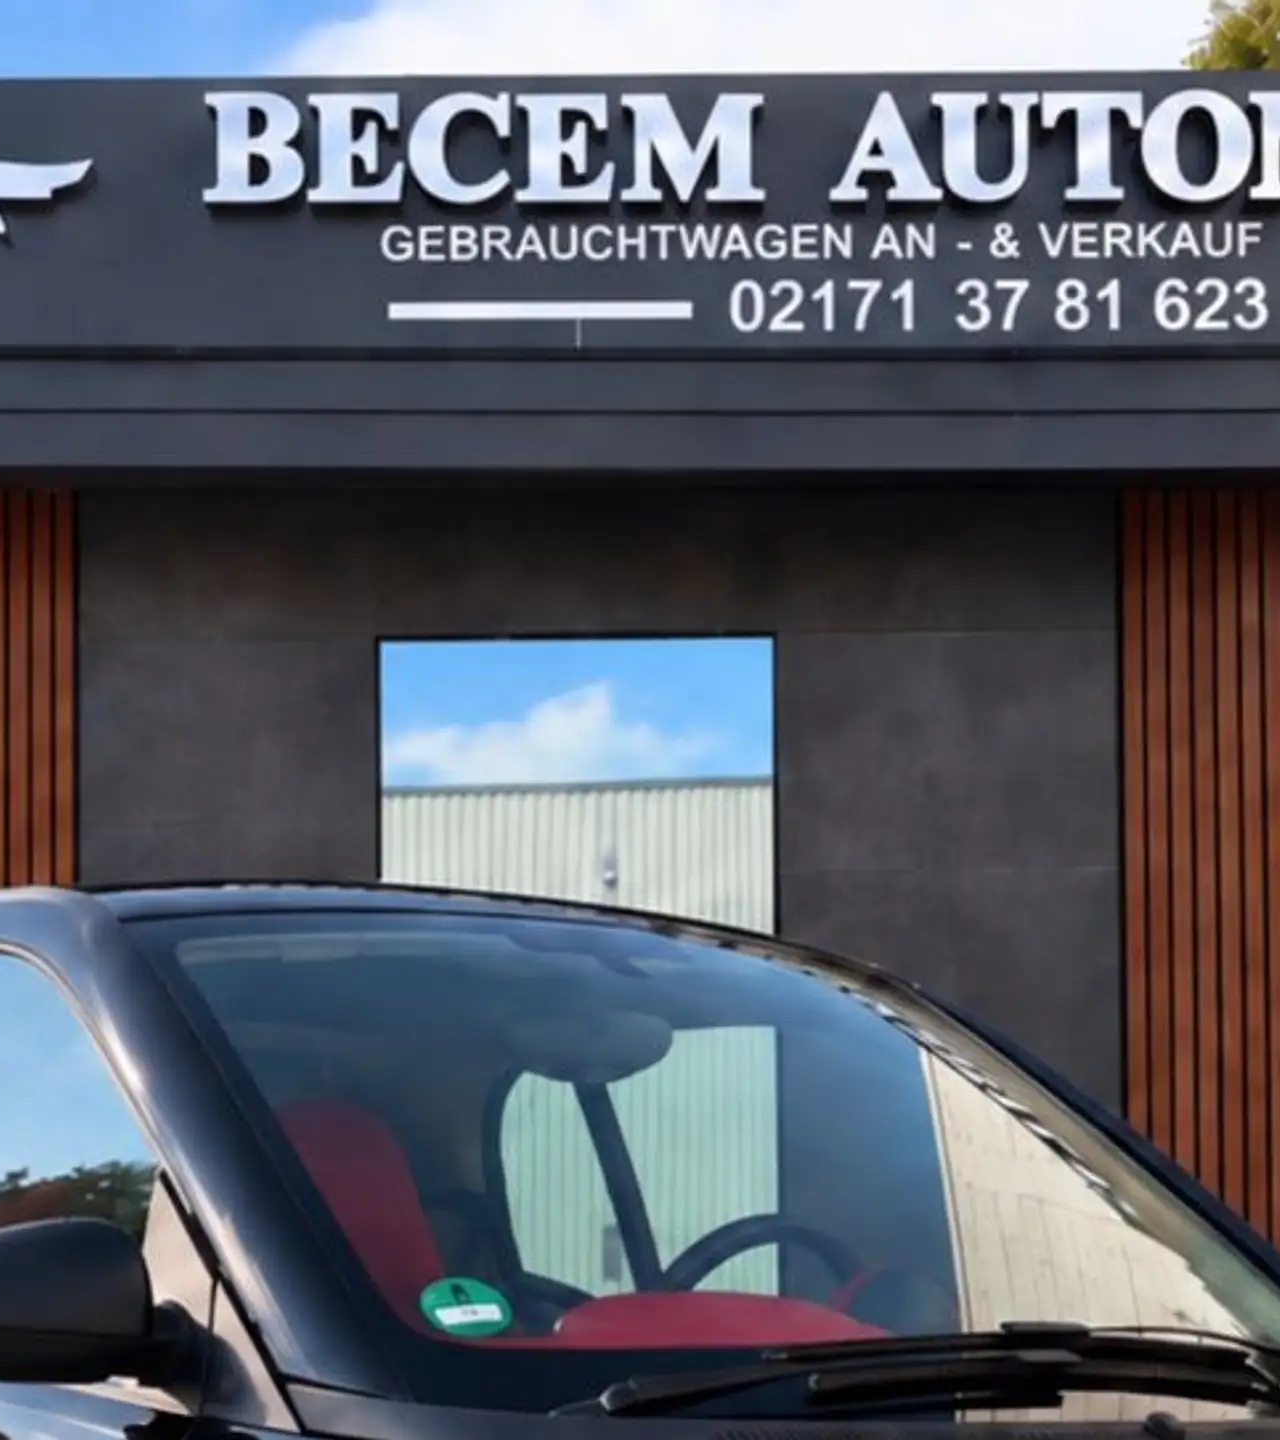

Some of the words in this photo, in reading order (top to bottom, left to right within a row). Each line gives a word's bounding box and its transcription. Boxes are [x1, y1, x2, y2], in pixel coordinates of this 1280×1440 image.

[202, 91, 766, 205] BECEM
[380, 223, 853, 262] GEBRAUCHTWAGEN
[870, 223, 936, 260] AN
[989, 222, 1021, 260] &
[1038, 221, 1263, 260] VERKAUF
[729, 279, 915, 333] 02171
[955, 278, 1031, 333] 37
[1054, 278, 1121, 332] 81
[1154, 277, 1270, 332] 623
